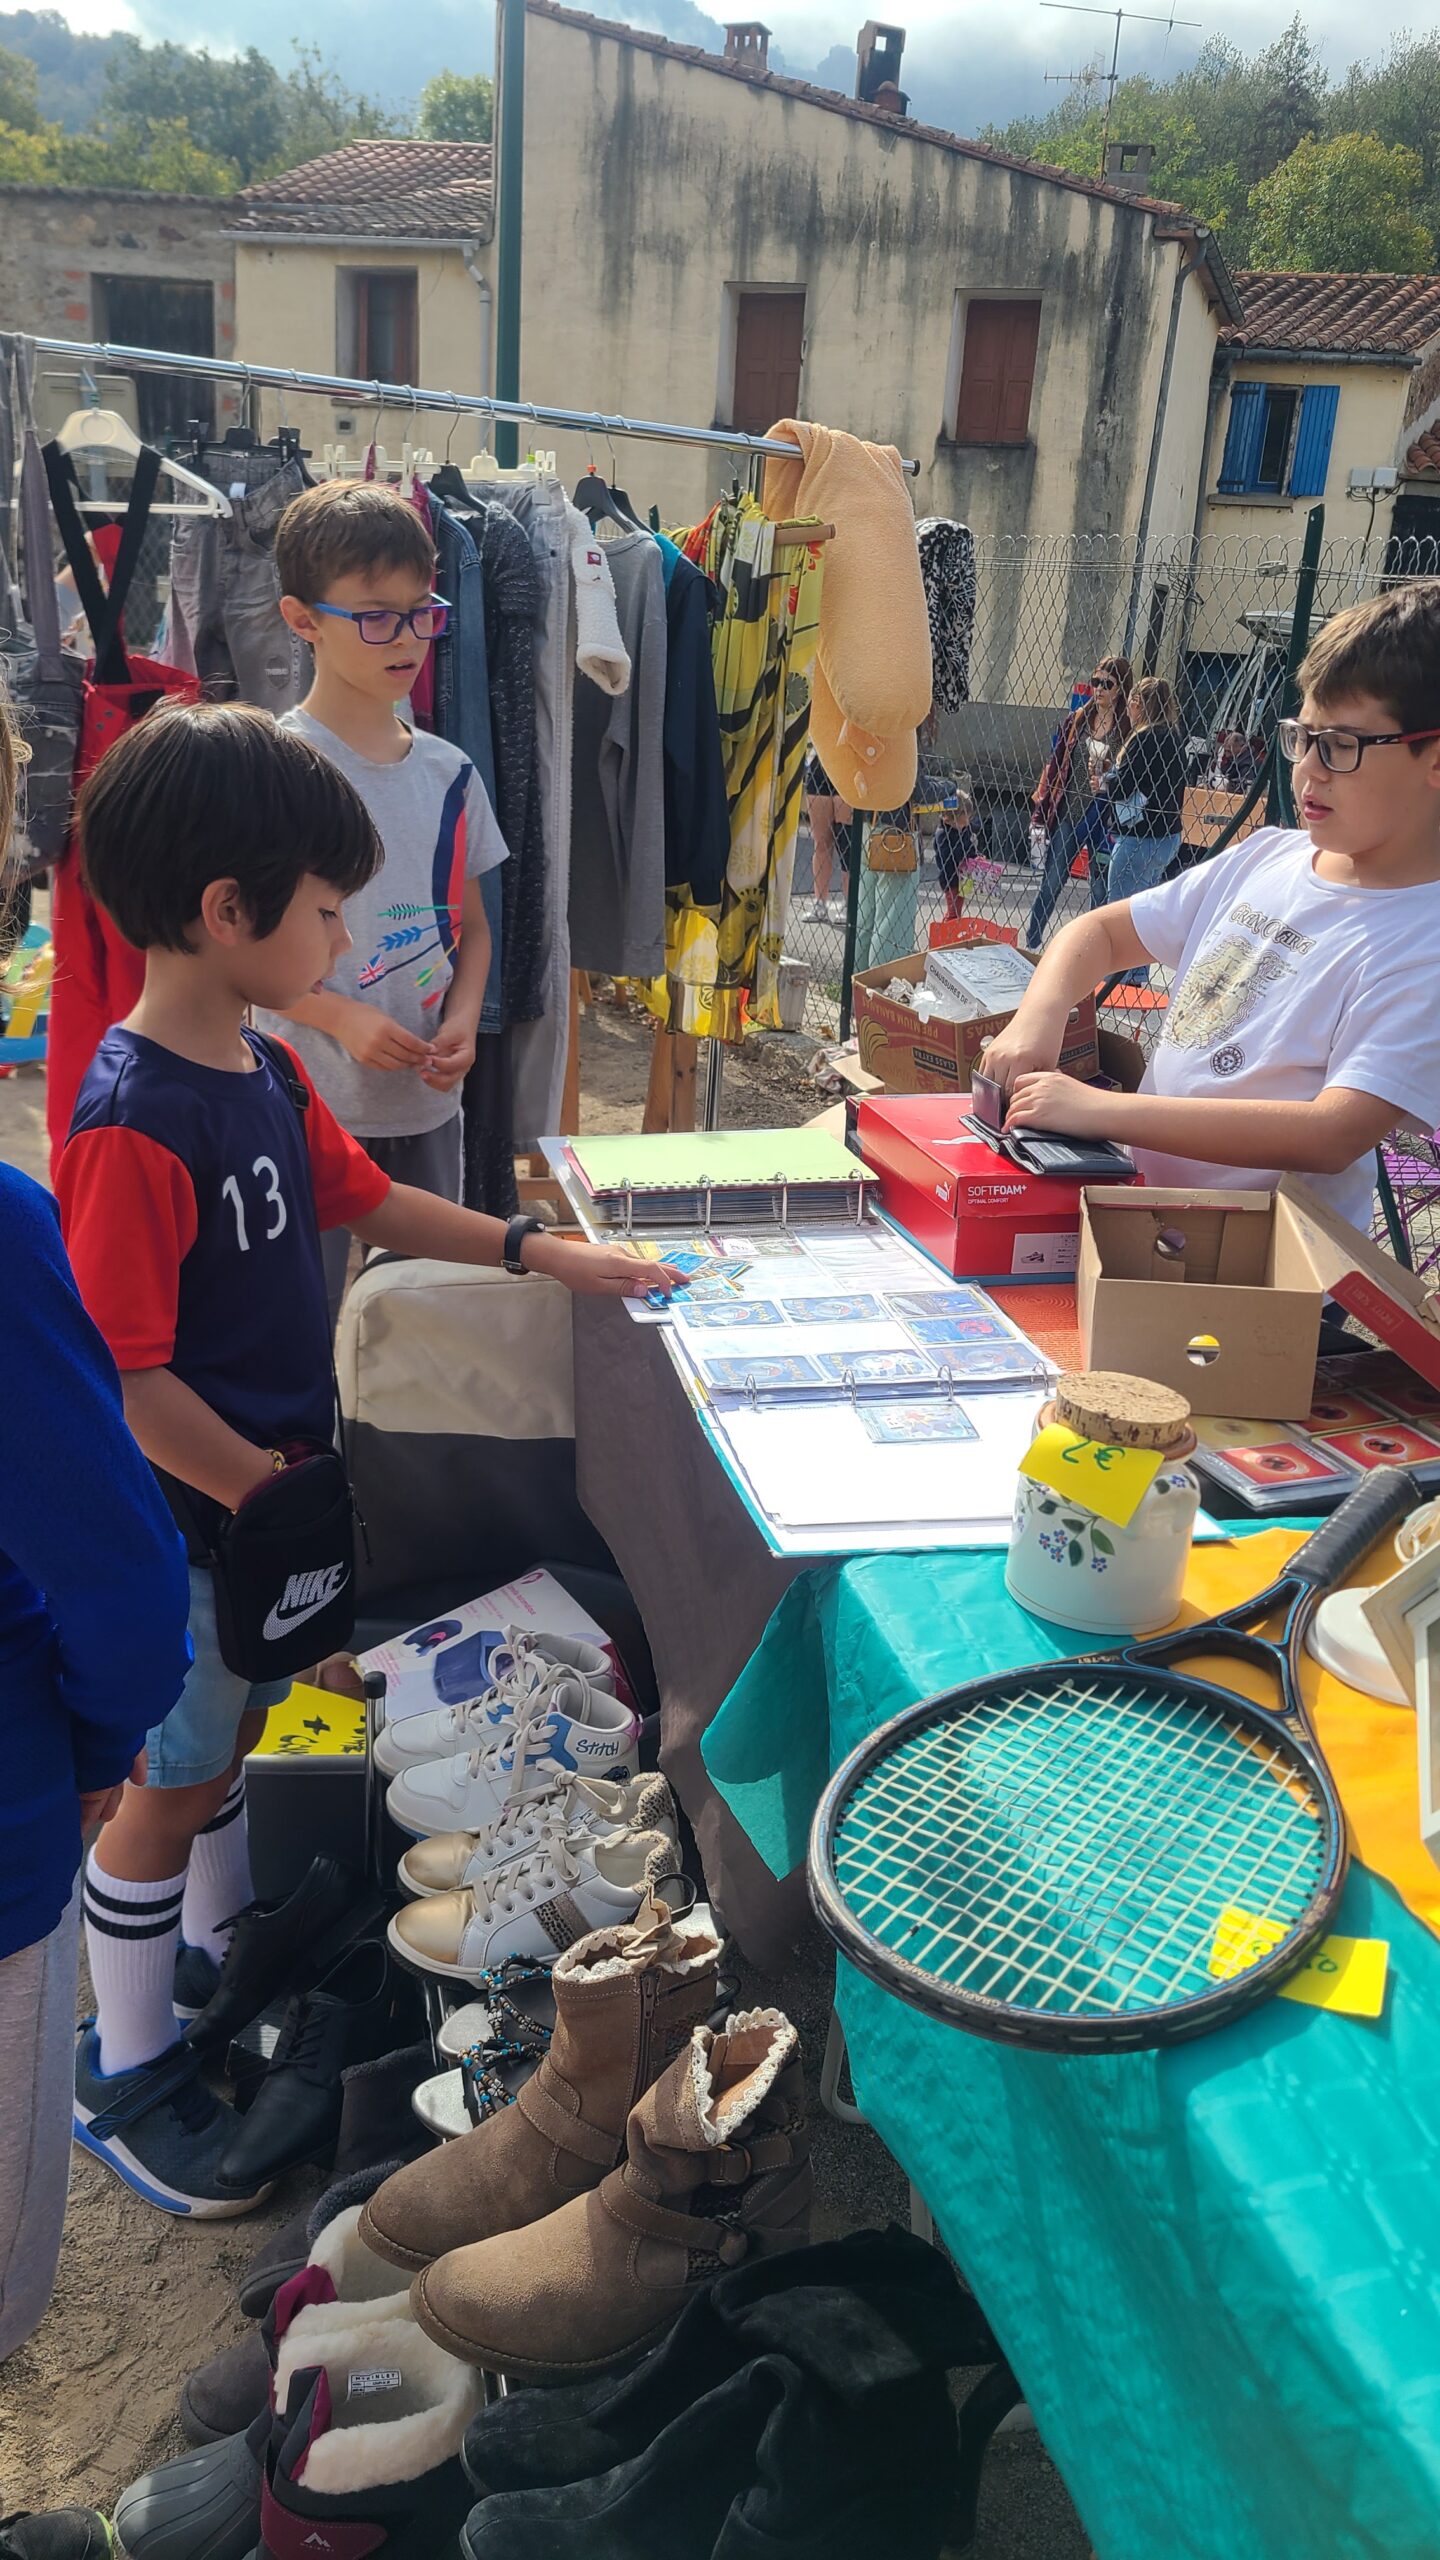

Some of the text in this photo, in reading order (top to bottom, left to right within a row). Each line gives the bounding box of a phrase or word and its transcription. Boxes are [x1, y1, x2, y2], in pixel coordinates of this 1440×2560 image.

[929, 964, 960, 998] CHAUSSURES
[896, 1014, 939, 1039] PREMIUM
[935, 1057, 956, 1070] CLASS
[222, 1155, 287, 1252] 13
[279, 1560, 344, 1612] NIKE
[942, 1981, 1001, 2008] GRAPHITE
